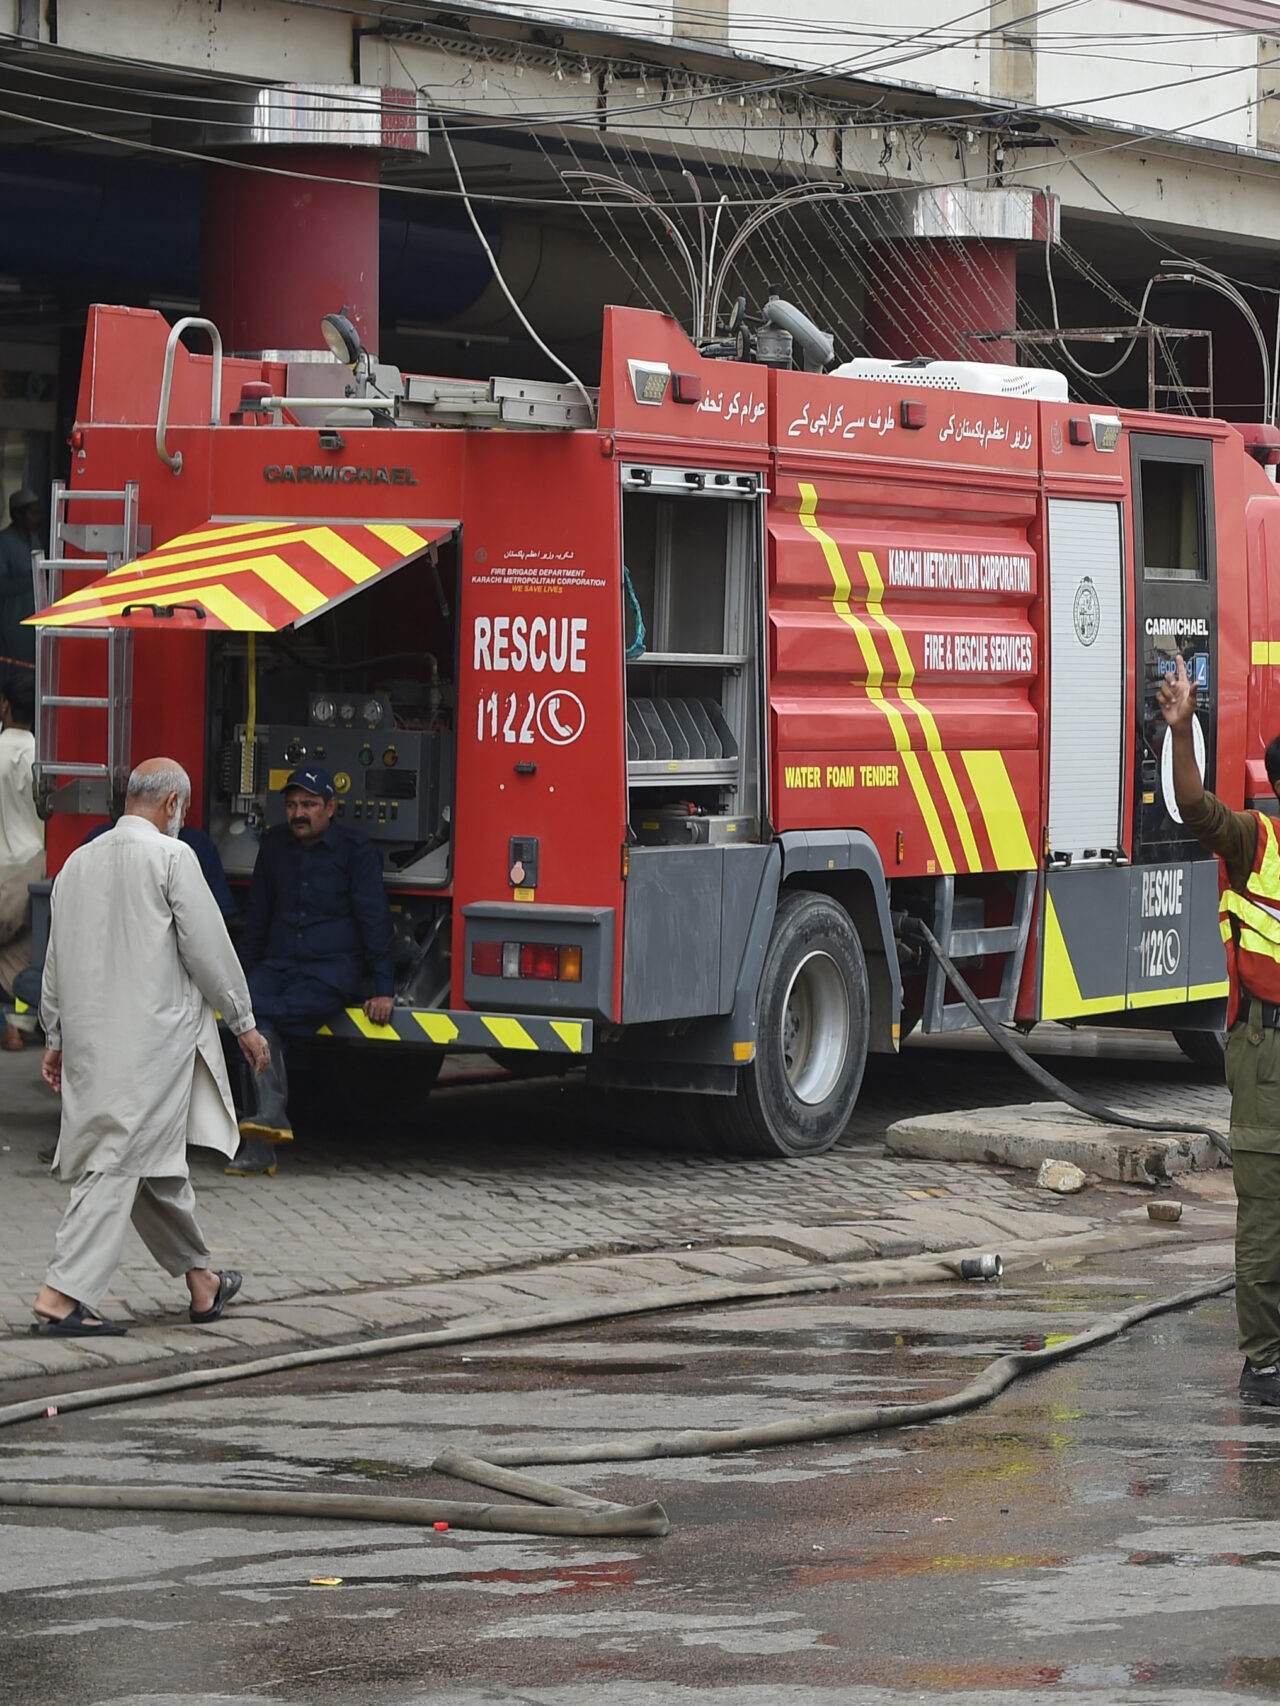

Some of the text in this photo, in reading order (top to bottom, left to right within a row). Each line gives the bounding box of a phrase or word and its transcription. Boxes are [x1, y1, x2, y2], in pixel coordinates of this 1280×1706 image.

[740, 392, 766, 426] عوام
[810, 403, 844, 437] کراچی
[868, 405, 895, 436] طرف
[955, 419, 987, 447] پاکستان
[985, 417, 1010, 449] اعظم
[1009, 424, 1032, 449] وزیر
[263, 464, 419, 486] CARMICHAEL
[471, 576, 606, 587] KARACHI METROPOLITAN CORPORATION
[490, 568, 585, 577] FIRE BRIGADE DEPARTMENT
[888, 549, 1031, 592] KARACHI METROPOLITAN CORPORATION
[511, 585, 563, 594] WE SAVE LIVES
[1145, 618, 1209, 636] CARMICHAEL
[473, 616, 588, 673] RESCUE
[924, 634, 1032, 671] FIRE & RESCUE SERVICES
[477, 690, 536, 744] 1122
[785, 766, 899, 788] WATER FOAM TENDER
[1141, 869, 1183, 918] RESCUE
[1140, 929, 1163, 977] 1122
